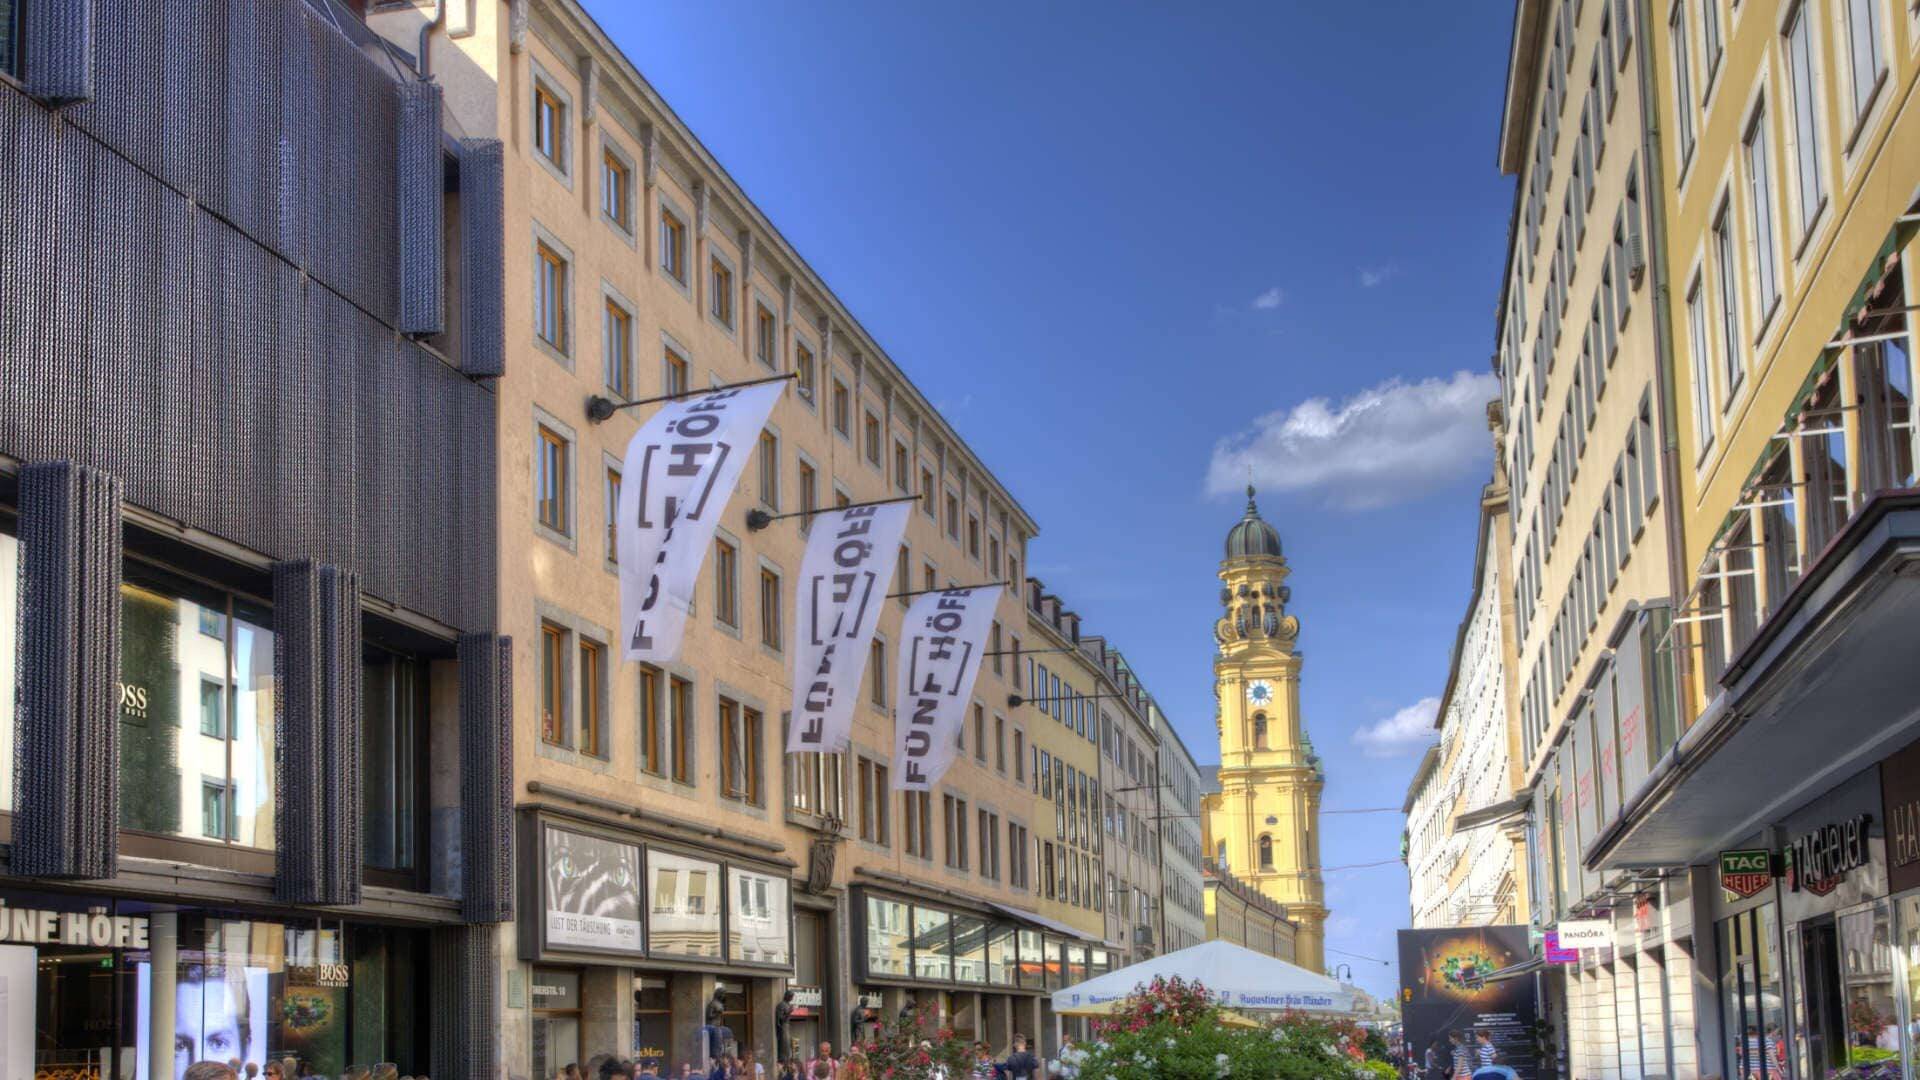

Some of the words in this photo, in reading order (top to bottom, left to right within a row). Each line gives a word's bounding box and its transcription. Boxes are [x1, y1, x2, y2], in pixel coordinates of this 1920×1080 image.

[1724, 856, 1767, 871] TAG
[1725, 874, 1769, 894] HEUER
[61, 906, 149, 949] HÖFE
[566, 918, 578, 932] DER
[320, 963, 349, 982] BOSS
[1239, 993, 1284, 1005] Augustiner
